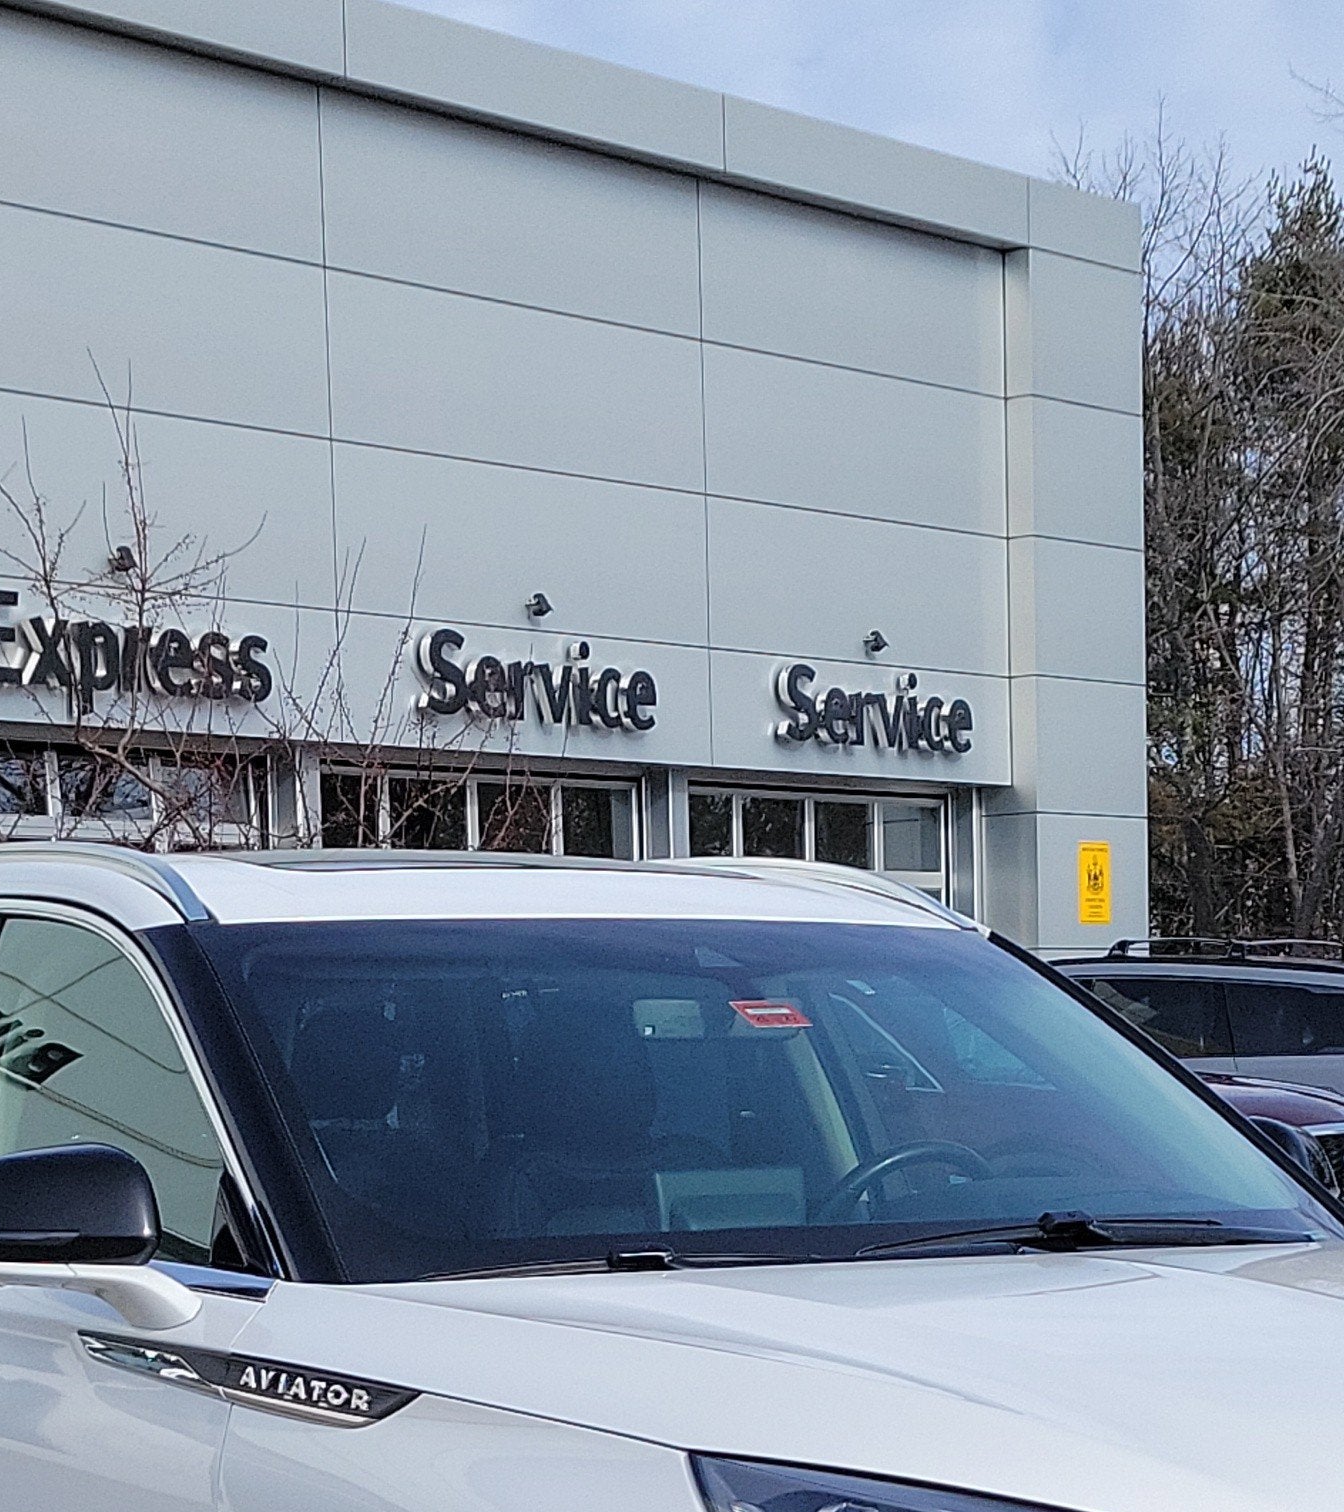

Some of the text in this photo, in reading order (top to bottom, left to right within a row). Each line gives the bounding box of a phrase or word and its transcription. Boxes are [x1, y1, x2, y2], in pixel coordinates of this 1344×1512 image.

[419, 627, 658, 731] Service
[775, 663, 974, 754] Service
[239, 1365, 371, 1412] AVIATOR
